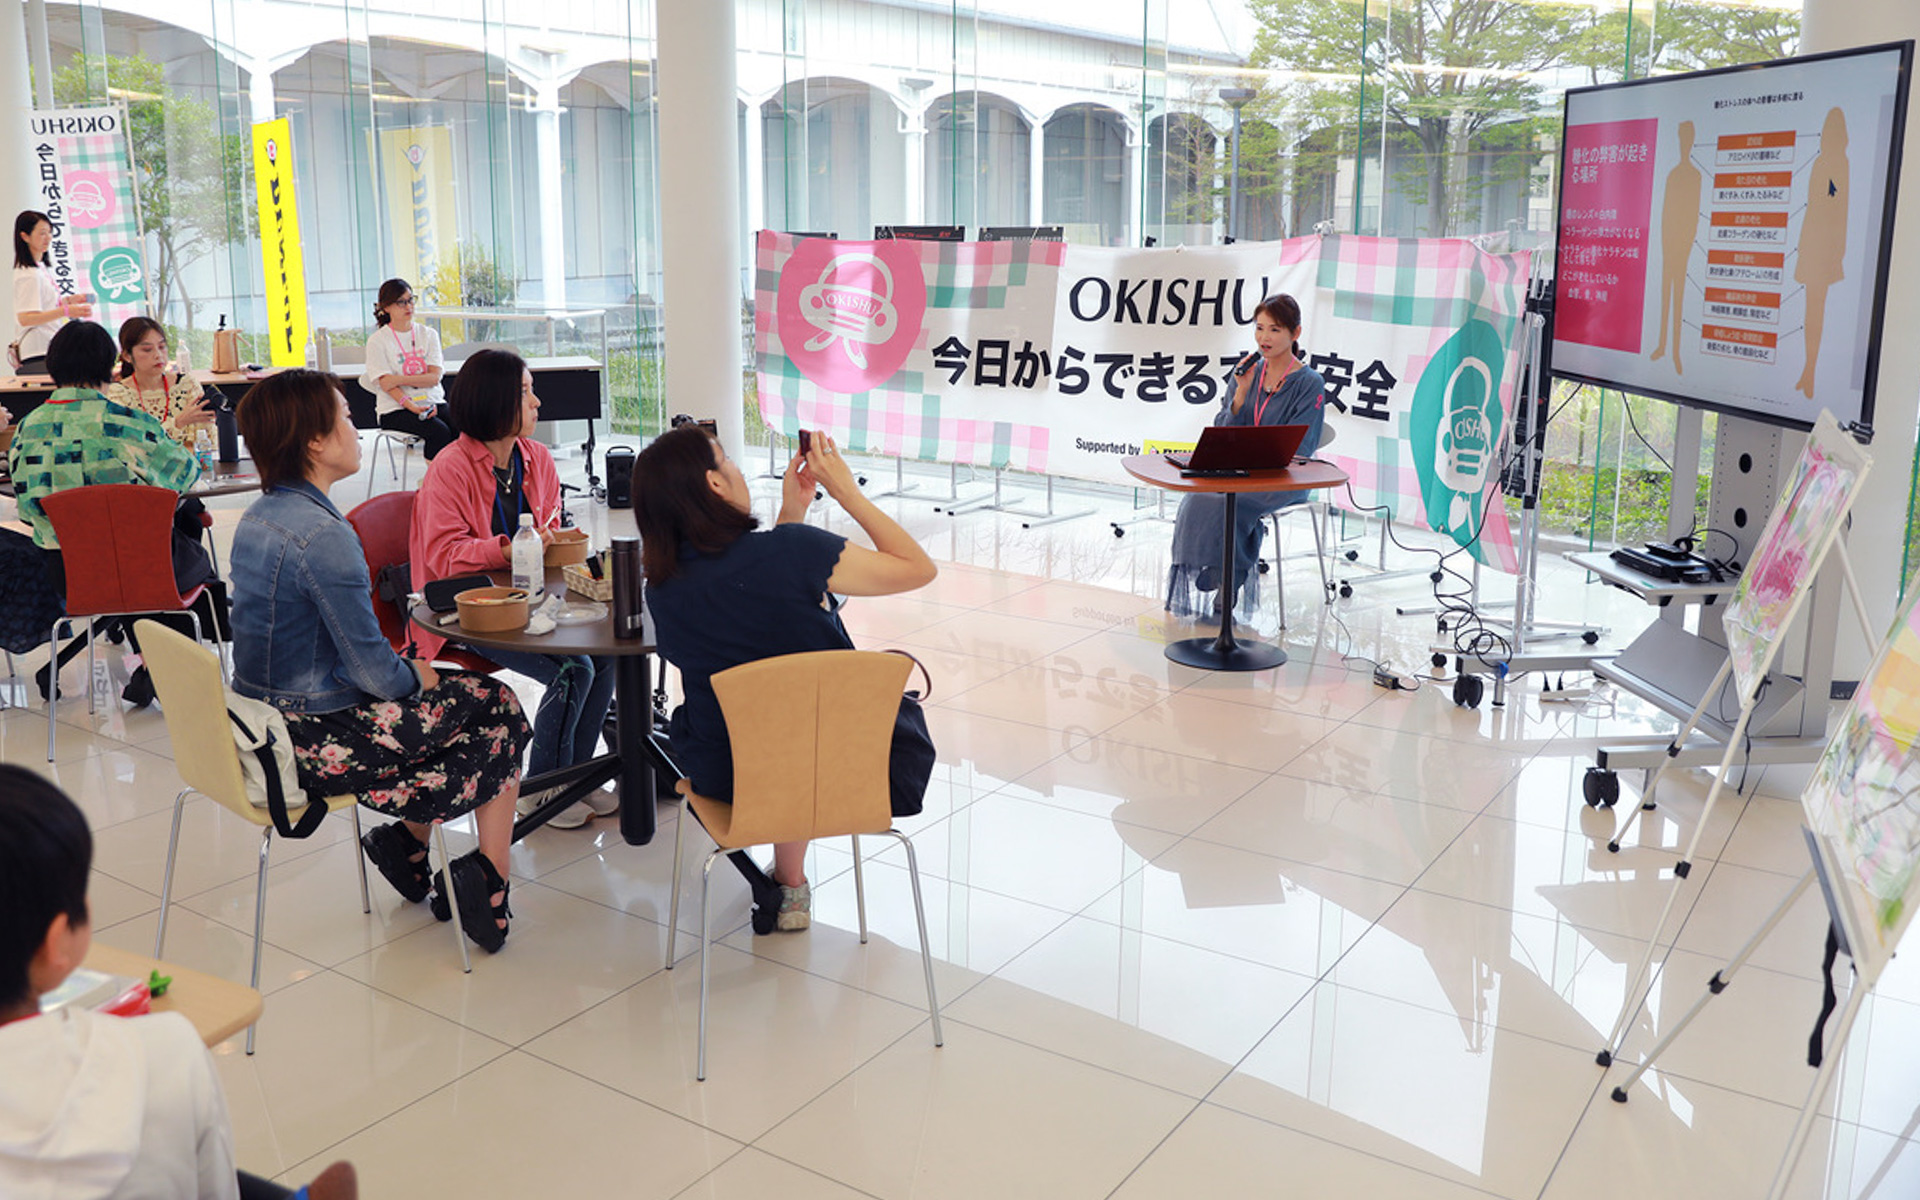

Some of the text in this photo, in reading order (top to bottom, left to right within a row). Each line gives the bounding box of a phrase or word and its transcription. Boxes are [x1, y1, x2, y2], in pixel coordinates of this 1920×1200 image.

[826, 294, 877, 315] OKISHU
[1069, 277, 1269, 326] OKISHU
[932, 336, 1397, 421] 今日からできる安全
[1076, 438, 1126, 455] Supported
